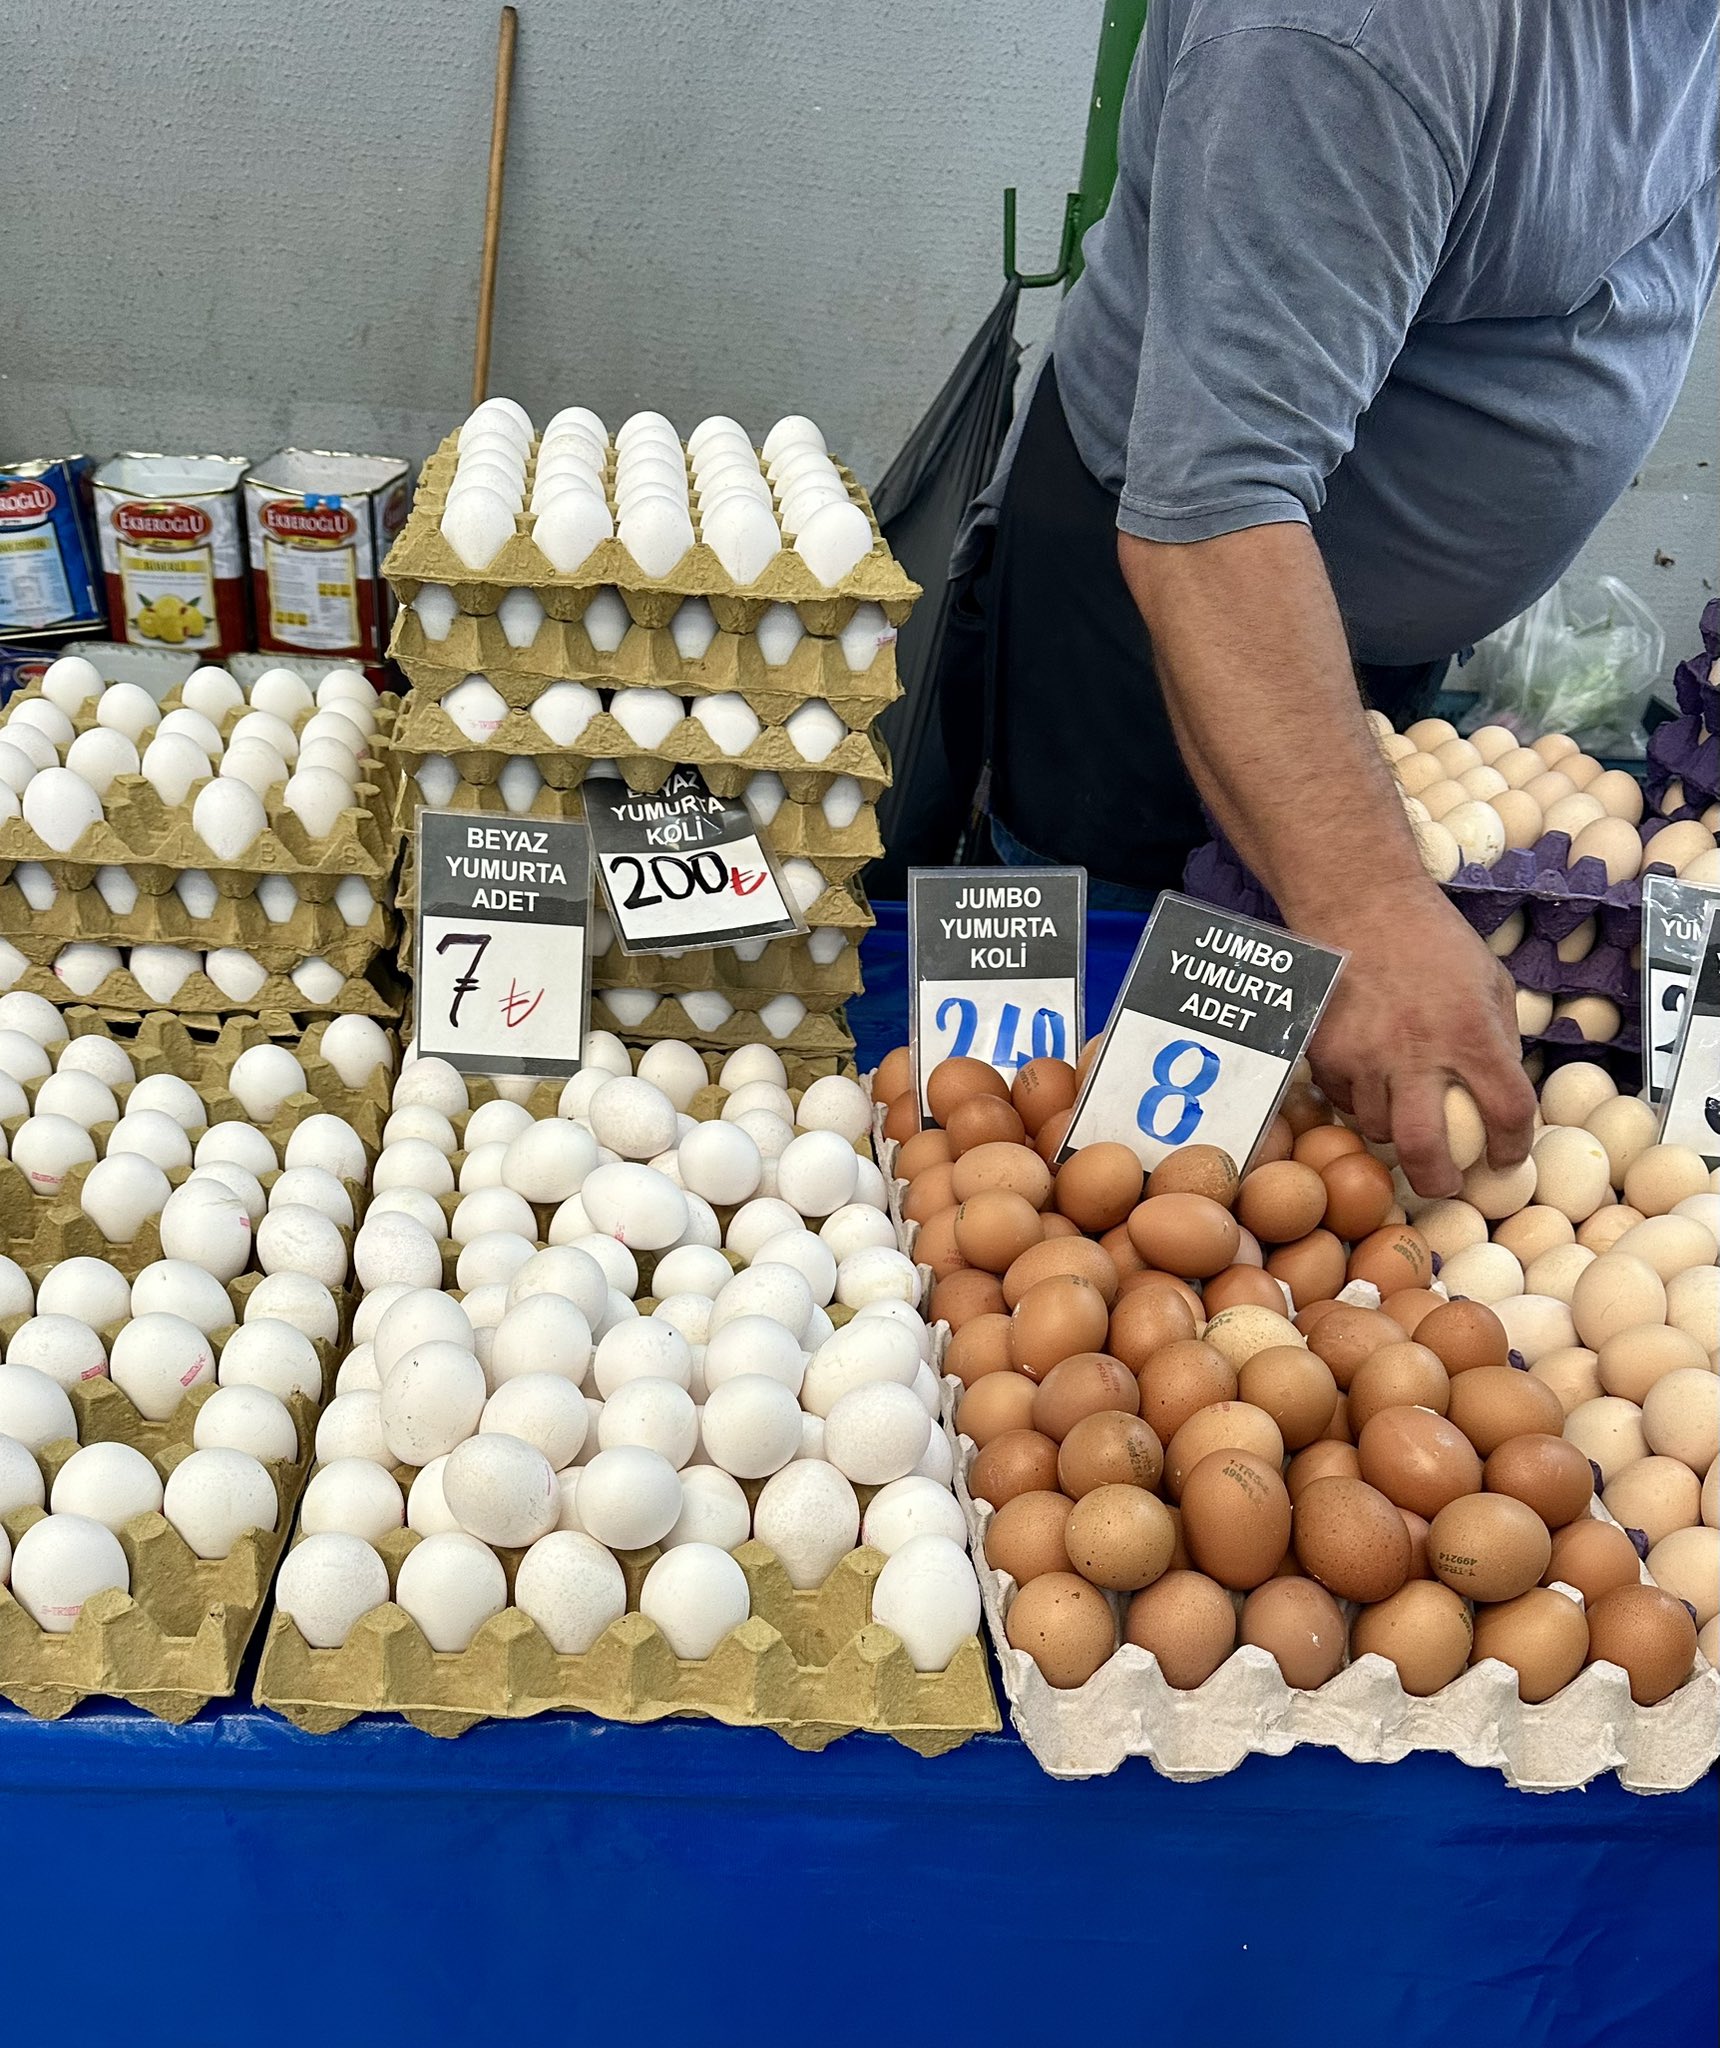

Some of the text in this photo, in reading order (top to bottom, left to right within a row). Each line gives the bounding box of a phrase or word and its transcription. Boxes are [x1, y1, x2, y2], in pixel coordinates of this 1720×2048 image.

[627, 771, 700, 798] YAZ
[610, 795, 726, 821] YUMURTA
[466, 827, 549, 854] BEYAZ
[646, 816, 703, 845] KOLİ
[446, 856, 567, 885] YUMURTA
[471, 888, 540, 912] ADET
[955, 887, 1042, 909] JUMBO
[939, 917, 1058, 939] YUMURTA
[970, 942, 1027, 969] KOLİ
[1195, 926, 1294, 974] JUMBO
[436, 933, 491, 1028] 7
[1169, 950, 1294, 1012] YUMURTA
[1179, 993, 1257, 1032] ADET
[1136, 1038, 1221, 1146] 8
[1439, 1552, 1478, 1566] 499214
